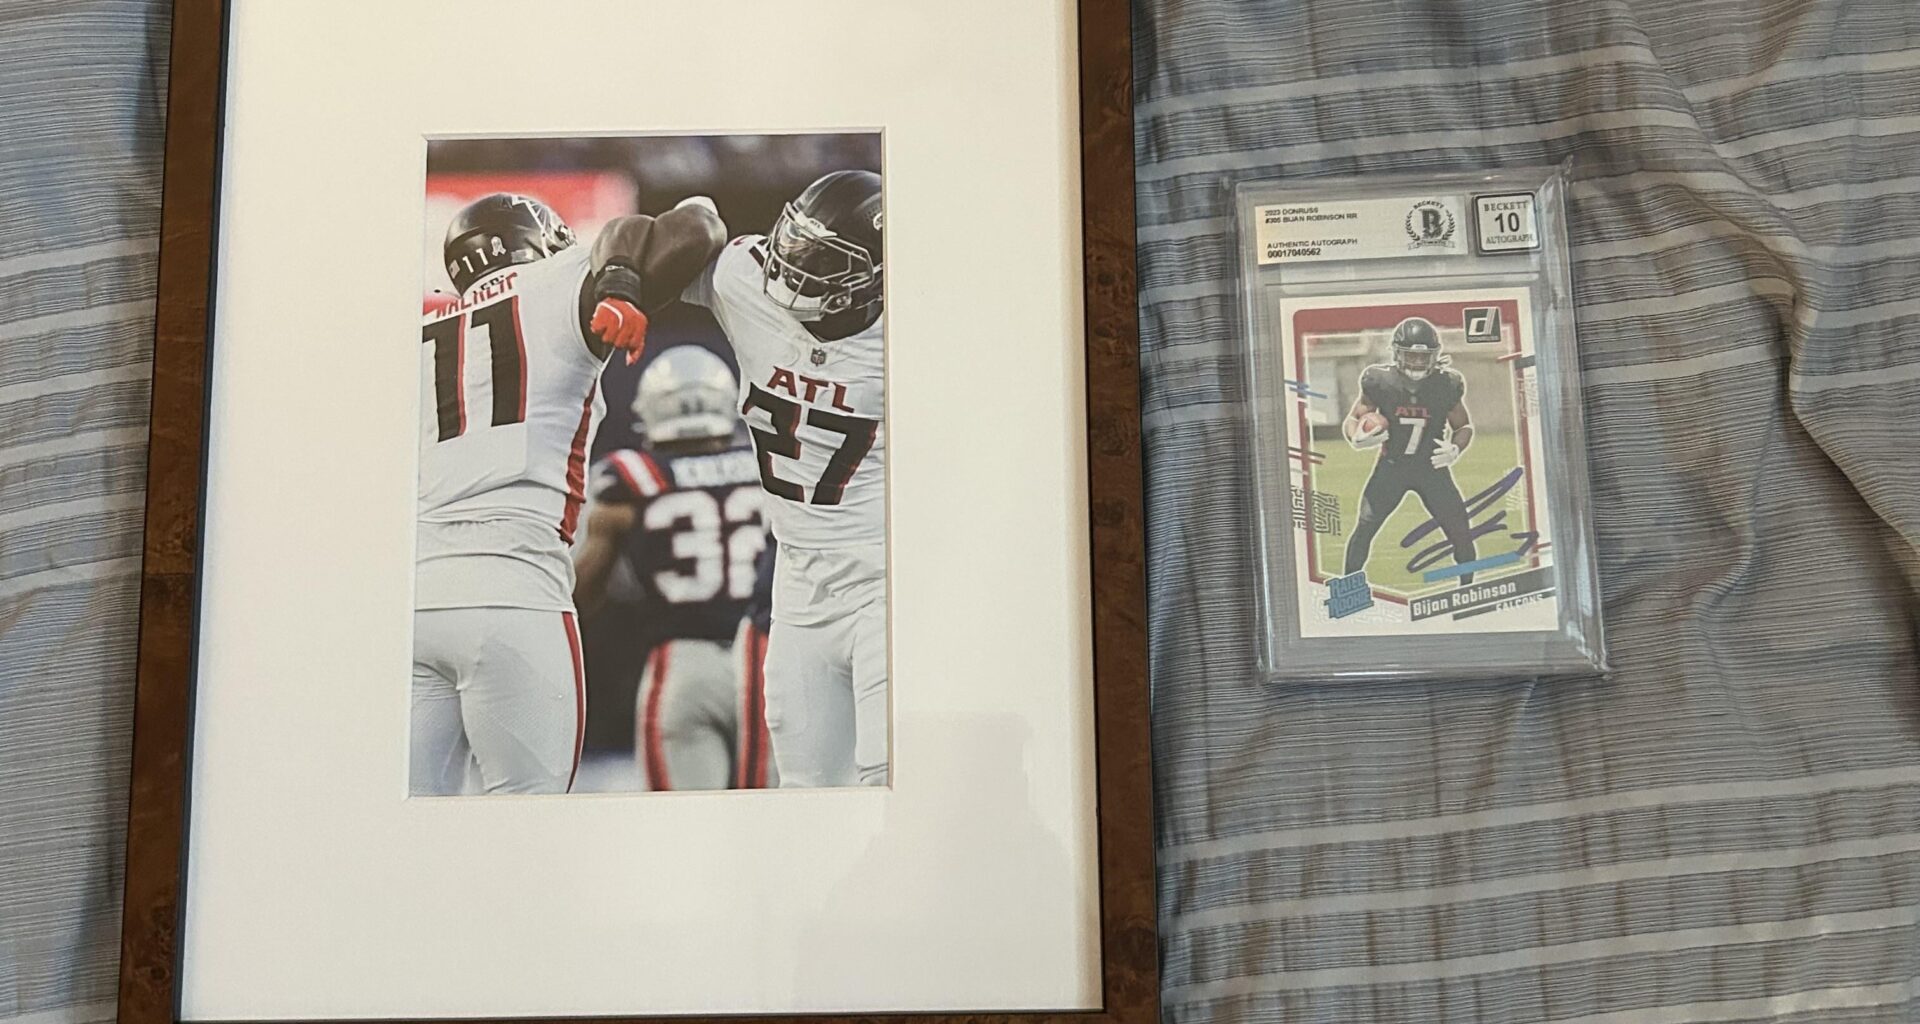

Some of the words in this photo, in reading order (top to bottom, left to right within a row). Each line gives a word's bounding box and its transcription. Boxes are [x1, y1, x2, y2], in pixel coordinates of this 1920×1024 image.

[1265, 209, 1281, 217] 2023
[1282, 207, 1319, 216] DONRUSS
[1413, 200, 1444, 209] BECKETT
[1484, 201, 1528, 212] BECKETT
[1306, 214, 1345, 222] ROBINSON
[1494, 212, 1520, 233] 10
[1267, 240, 1310, 249] AUTHENTIC
[1311, 238, 1358, 246] AUTOGRAPH
[1485, 233, 1533, 245] AUTOGRAPH
[462, 247, 489, 273] 11
[1267, 247, 1321, 258] 00017040562
[422, 295, 527, 443] 11
[767, 365, 855, 414] ATL
[1394, 406, 1431, 418] ATL
[742, 382, 880, 506] 27
[1399, 417, 1426, 455] 7
[643, 485, 771, 603] 32
[1412, 598, 1449, 617] Bijan
[1452, 581, 1517, 608] Robinson
[1495, 594, 1543, 613] FALCONS
